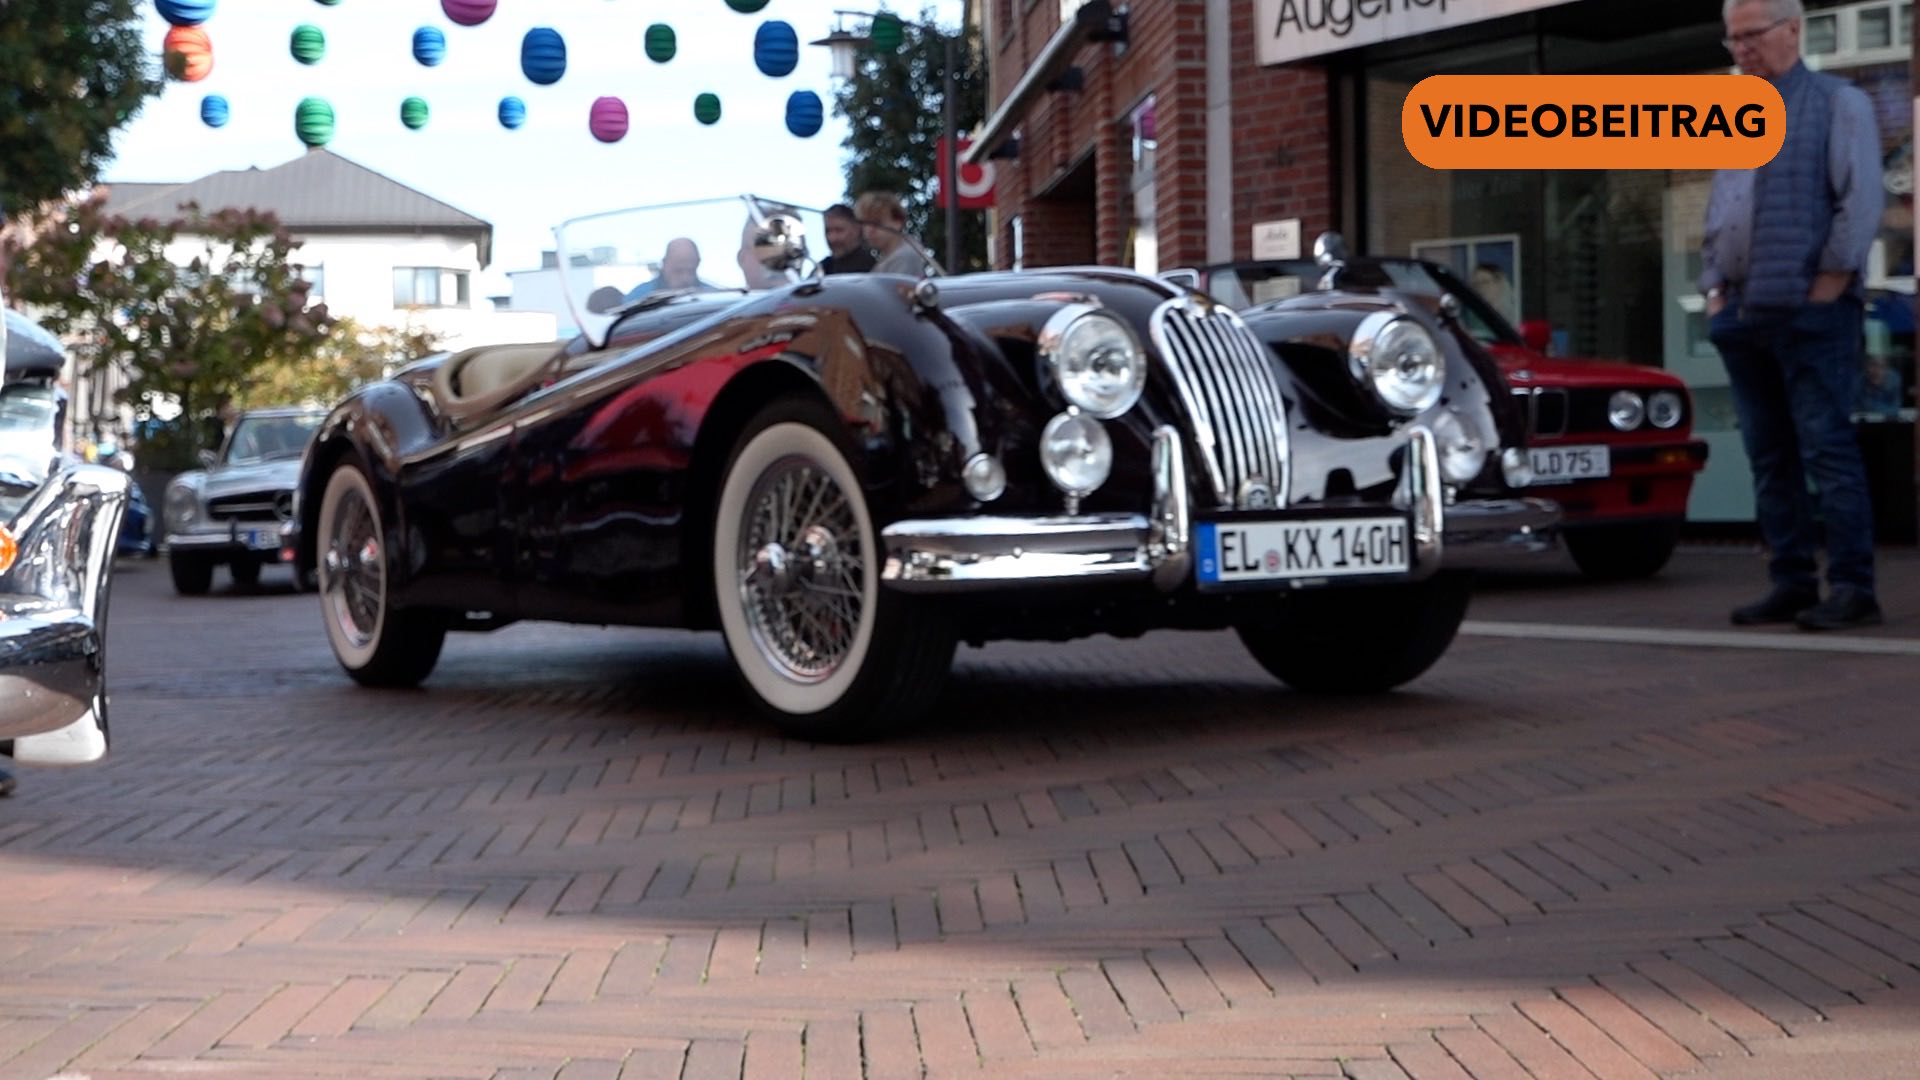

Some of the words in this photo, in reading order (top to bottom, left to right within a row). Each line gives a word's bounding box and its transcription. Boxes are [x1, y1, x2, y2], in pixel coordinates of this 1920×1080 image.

[1274, 0, 1446, 38] Auge
[1220, 530, 1260, 572] EL
[1284, 528, 1323, 569] KX
[1331, 525, 1406, 567] 140H
